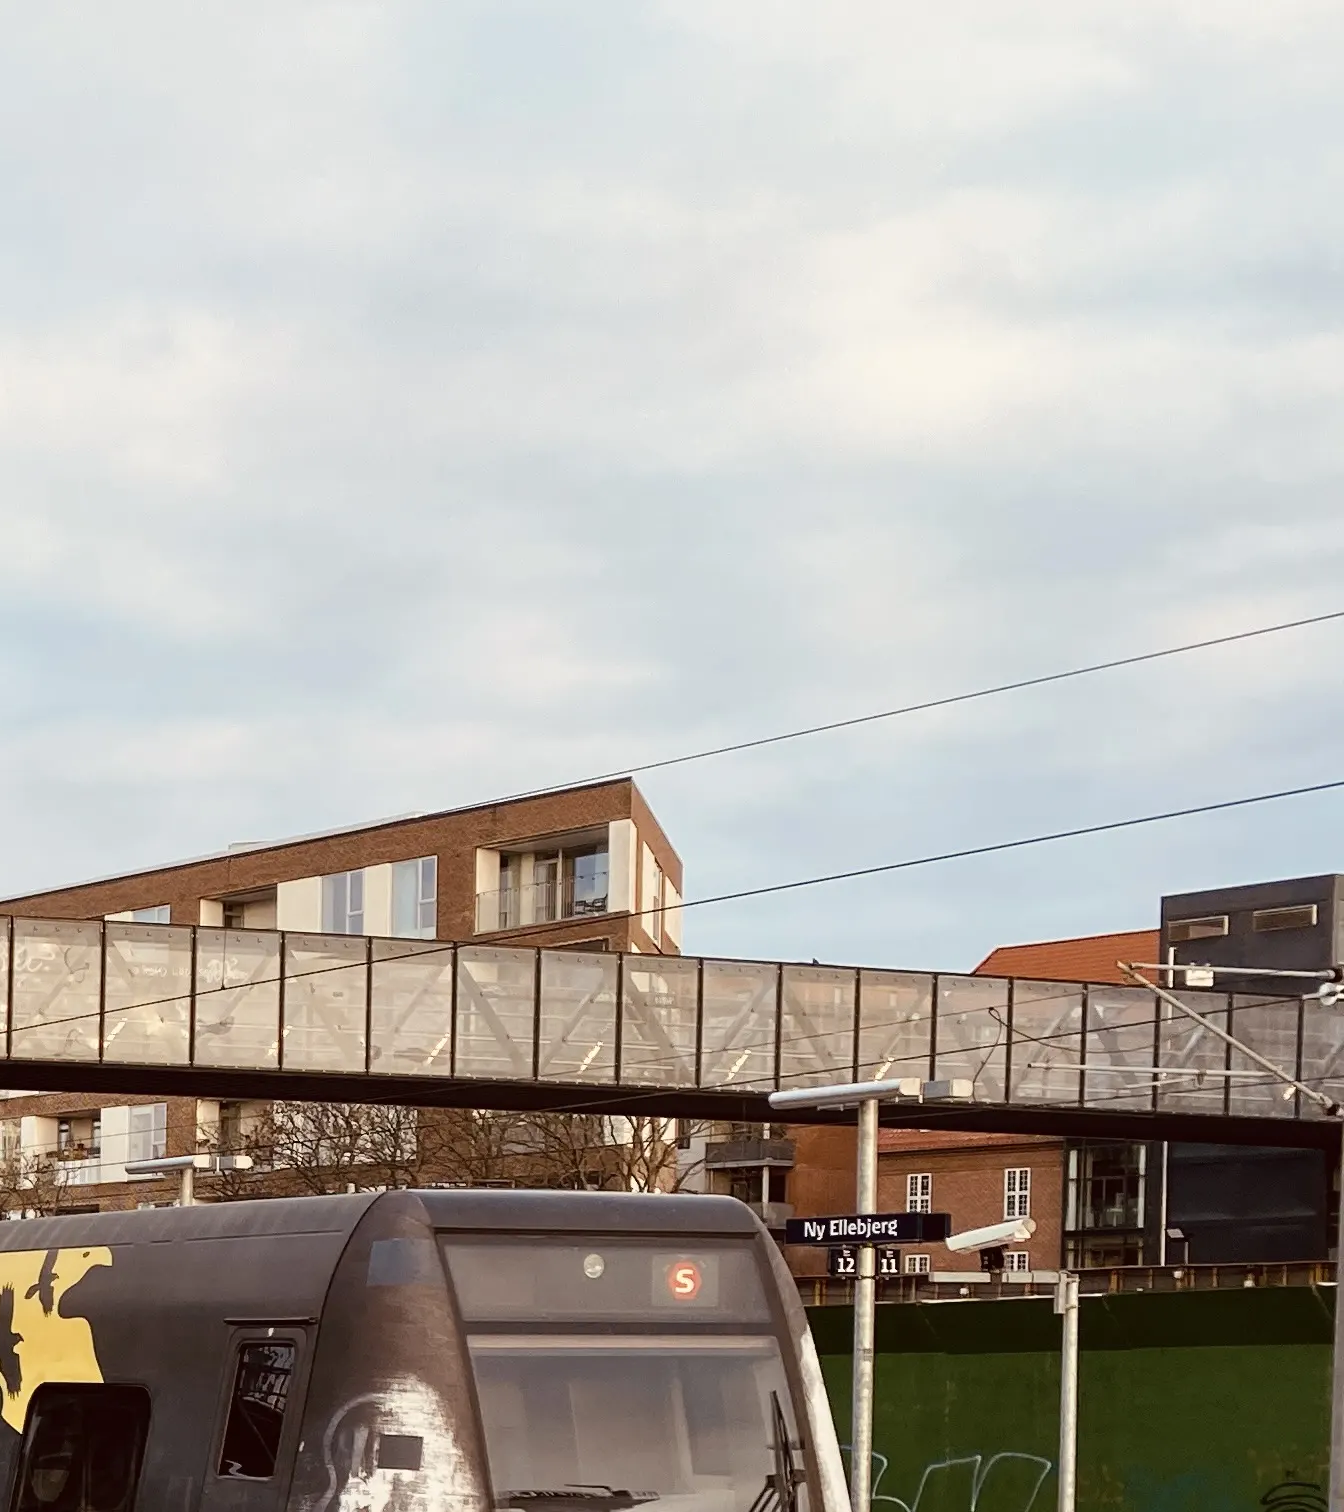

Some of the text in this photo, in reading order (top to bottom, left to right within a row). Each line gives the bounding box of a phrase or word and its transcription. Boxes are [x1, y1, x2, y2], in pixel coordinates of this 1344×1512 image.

[804, 1218, 898, 1241] Ny Ellebjerg
[837, 1257, 855, 1273] 12
[880, 1258, 898, 1273] 11
[675, 1269, 695, 1293] S
